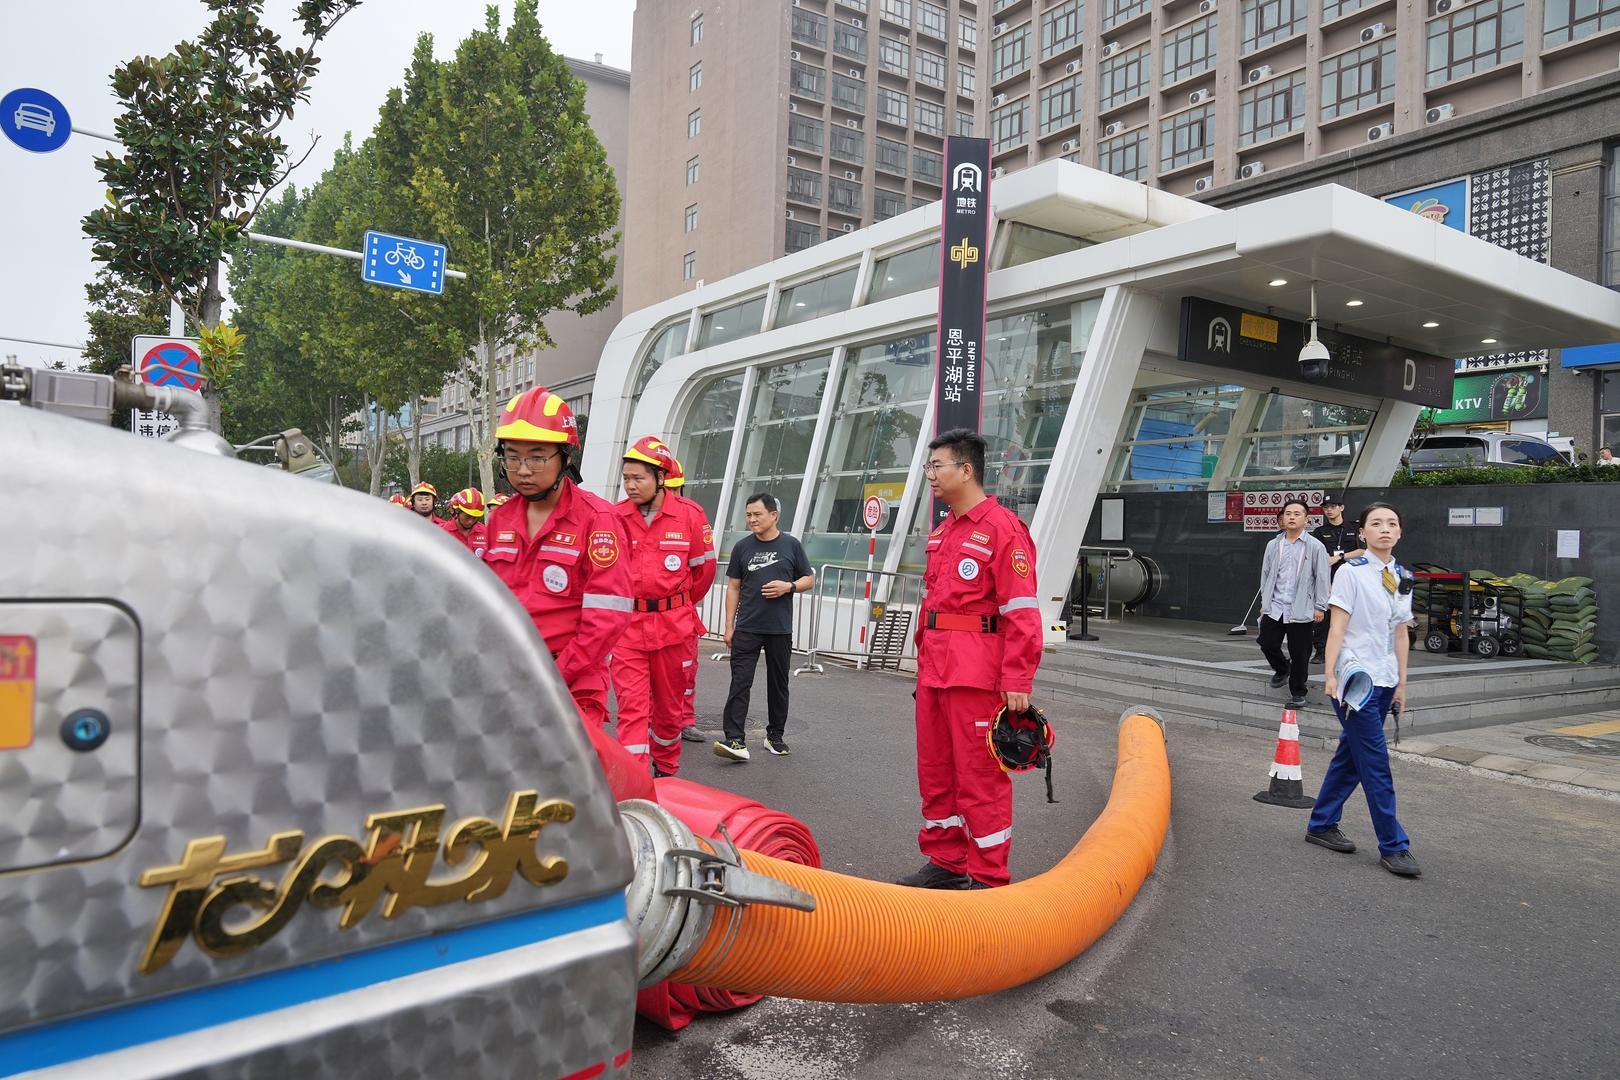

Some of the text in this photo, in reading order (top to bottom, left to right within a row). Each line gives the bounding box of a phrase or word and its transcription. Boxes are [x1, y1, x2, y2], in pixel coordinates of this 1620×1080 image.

[956, 197, 976, 208] 地铁
[944, 328, 963, 403] 恩平湖站
[967, 341, 976, 391] ENPINGHU
[1403, 358, 1416, 391] D
[1455, 397, 1482, 410] KTV
[139, 424, 178, 438] 违停
